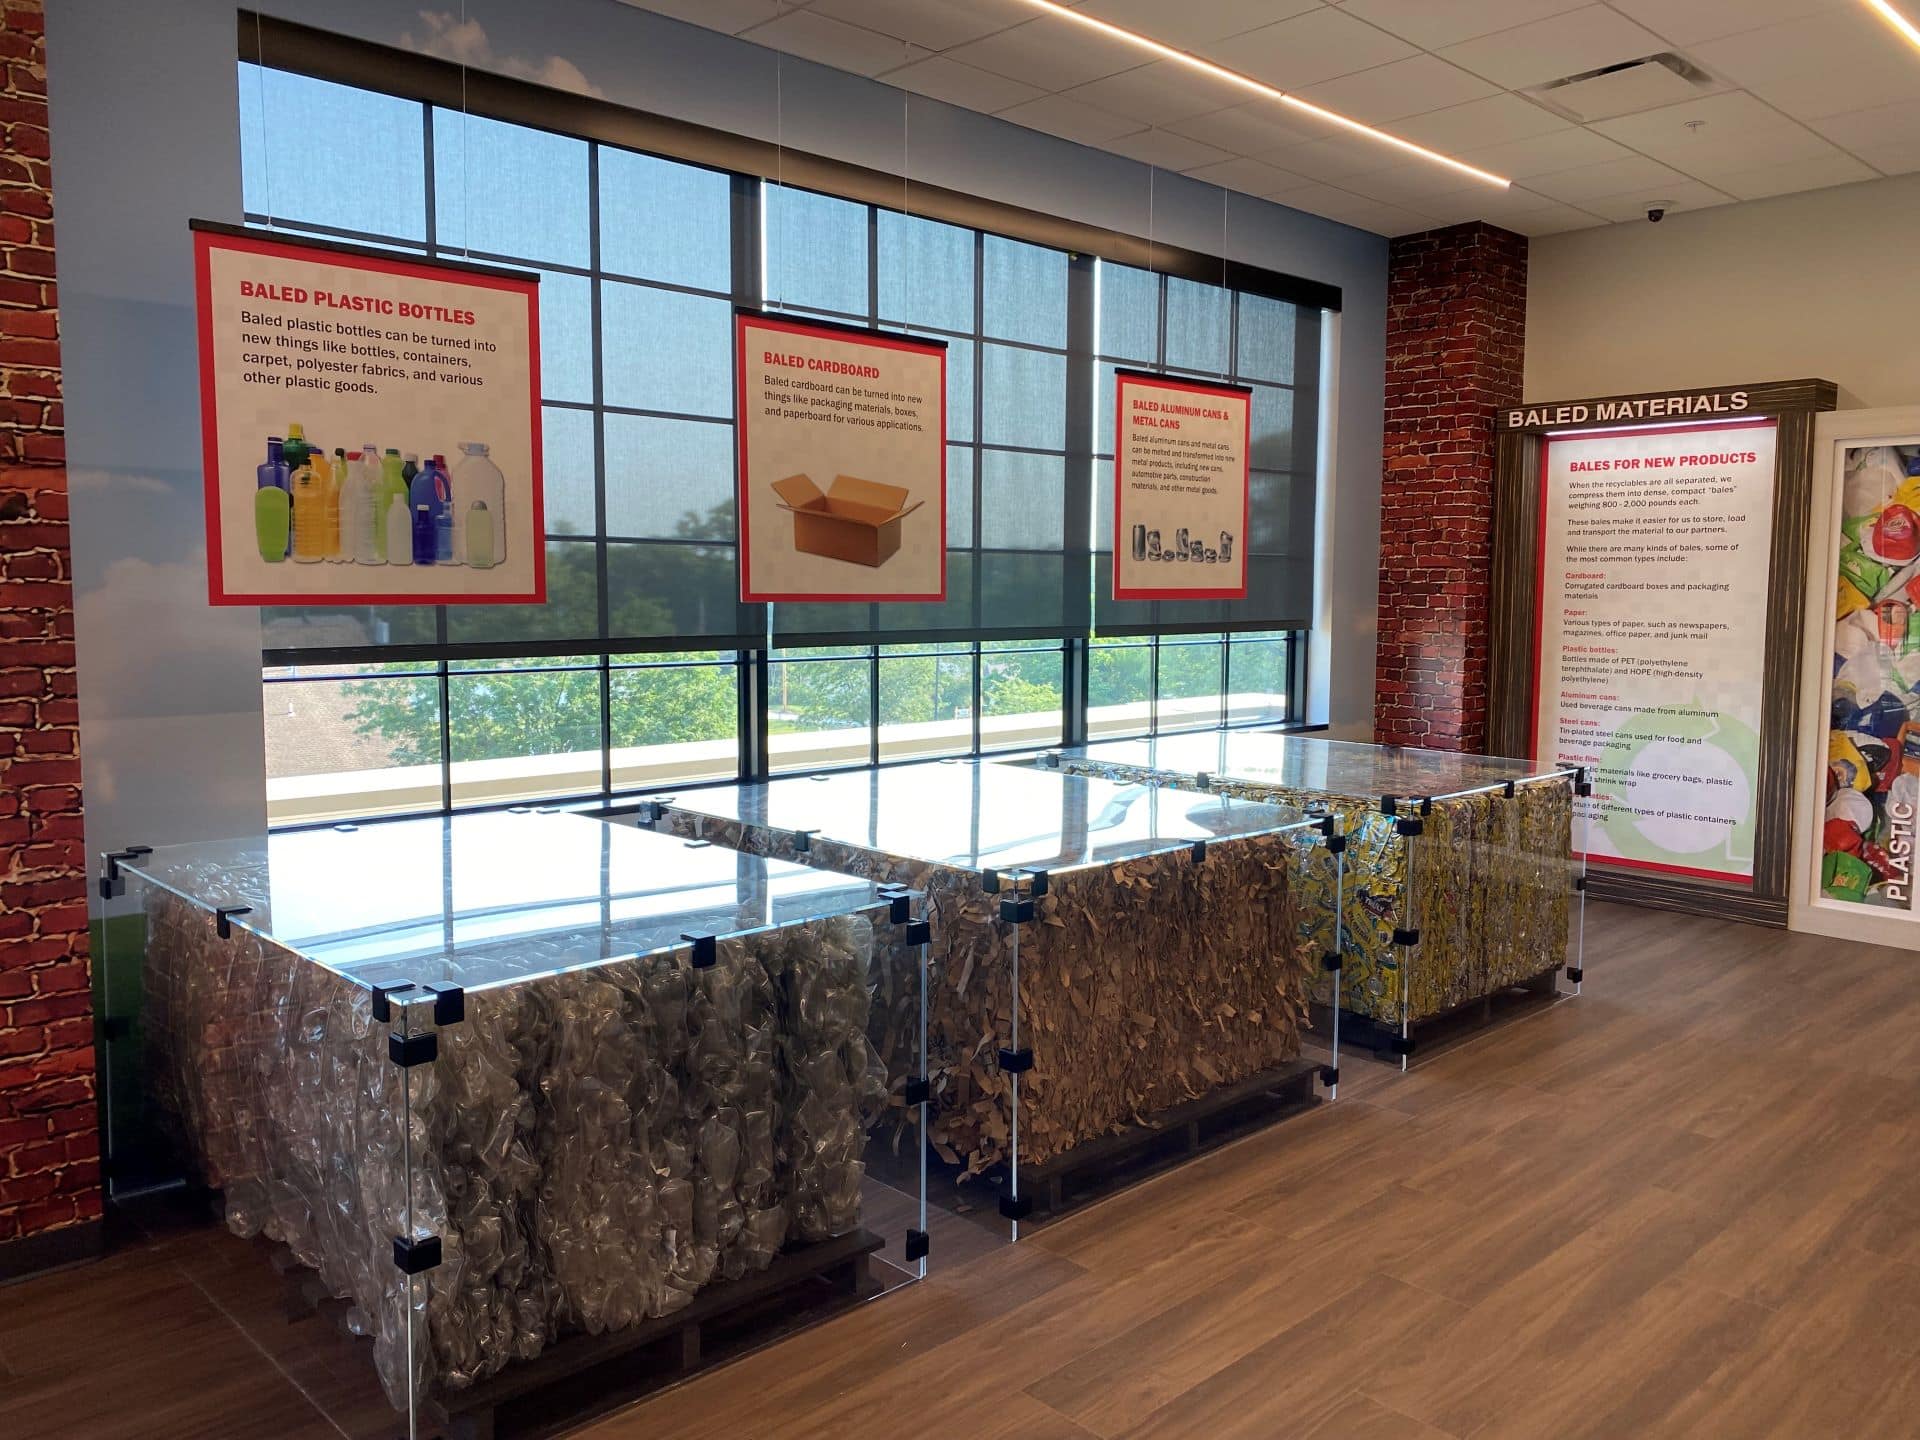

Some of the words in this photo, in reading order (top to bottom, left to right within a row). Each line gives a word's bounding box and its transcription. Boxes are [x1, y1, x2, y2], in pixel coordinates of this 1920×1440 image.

[240, 280, 308, 304] BALED
[314, 290, 393, 315] PLASTIC
[399, 302, 475, 326] BOTTLES
[241, 311, 282, 328] Baled
[287, 317, 332, 334] plastic
[336, 322, 382, 339] bottles
[385, 331, 408, 342] can
[412, 332, 428, 345] be
[431, 334, 470, 350] turned
[474, 339, 496, 353] into
[242, 334, 270, 346] new
[276, 334, 319, 353] things
[323, 340, 347, 354] like
[351, 343, 400, 362] bottles,
[403, 351, 472, 370] containers,
[242, 353, 293, 369] carpet,
[297, 358, 357, 374] polyester
[362, 363, 409, 381] fabrics,
[413, 370, 436, 382] and
[440, 373, 483, 386] various
[764, 351, 804, 369] BALED
[808, 357, 879, 379] CARDBOARD
[244, 371, 281, 385] other
[285, 375, 330, 390] plastic
[334, 381, 378, 394] goods.
[764, 375, 789, 388] Baled
[791, 380, 833, 393] cardboard
[835, 386, 850, 395] can
[852, 386, 862, 396] be
[864, 388, 889, 400] turned
[891, 391, 905, 402] into
[907, 395, 922, 404] new
[764, 391, 791, 405] things
[793, 394, 808, 405] like
[811, 398, 852, 412] packaging
[854, 403, 893, 416] materials,
[895, 406, 918, 419] boxes,
[1133, 400, 1159, 412] BALED
[1160, 403, 1201, 417] ALUMINUM
[1202, 408, 1222, 420] CANS
[1223, 411, 1229, 421] &
[1508, 405, 1589, 428] BALED
[1596, 391, 1749, 421] MATERIALS
[765, 407, 781, 417] and
[783, 410, 831, 422] paperboard
[833, 413, 844, 423] for
[847, 416, 875, 426] various
[1133, 415, 1158, 427] METAL
[1159, 418, 1180, 430] CANS
[1570, 460, 1610, 472] BALES
[1614, 458, 1640, 470] FOR
[1644, 456, 1675, 469] NEW
[1679, 452, 1757, 467] PRODUCTS
[1671, 488, 1706, 496] compact
[1568, 502, 1600, 510] weighing
[1648, 500, 1677, 508] pounds
[1582, 528, 1616, 537] transport
[1634, 556, 1655, 564] types
[1687, 584, 1730, 592] packaging
[1591, 620, 1611, 628] types
[1670, 632, 1688, 640] junk
[1562, 645, 1587, 653] Plastic
[1562, 655, 1587, 663] Bottles
[1561, 691, 1597, 700] Aluminum
[1580, 702, 1612, 712] beverage
[1634, 706, 1655, 714] made
[1657, 707, 1676, 715] from
[1678, 709, 1719, 718] aluminum
[1559, 737, 1591, 747] beverage
[1593, 741, 1631, 751] packaging
[1596, 730, 1614, 738] steel
[1667, 736, 1685, 744] food
[1558, 753, 1583, 762] Plastic
[1594, 776, 1617, 785] shrink
[1619, 780, 1636, 788] wrap
[1600, 768, 1635, 777] materials
[1636, 770, 1650, 778] like
[1652, 773, 1680, 782] grocery
[1706, 777, 1732, 786] plastic
[1601, 803, 1632, 814] different
[1634, 807, 1654, 817] types
[1666, 811, 1692, 821] plastic
[1694, 815, 1737, 826] containers
[1887, 802, 1913, 901] PLASTIC
